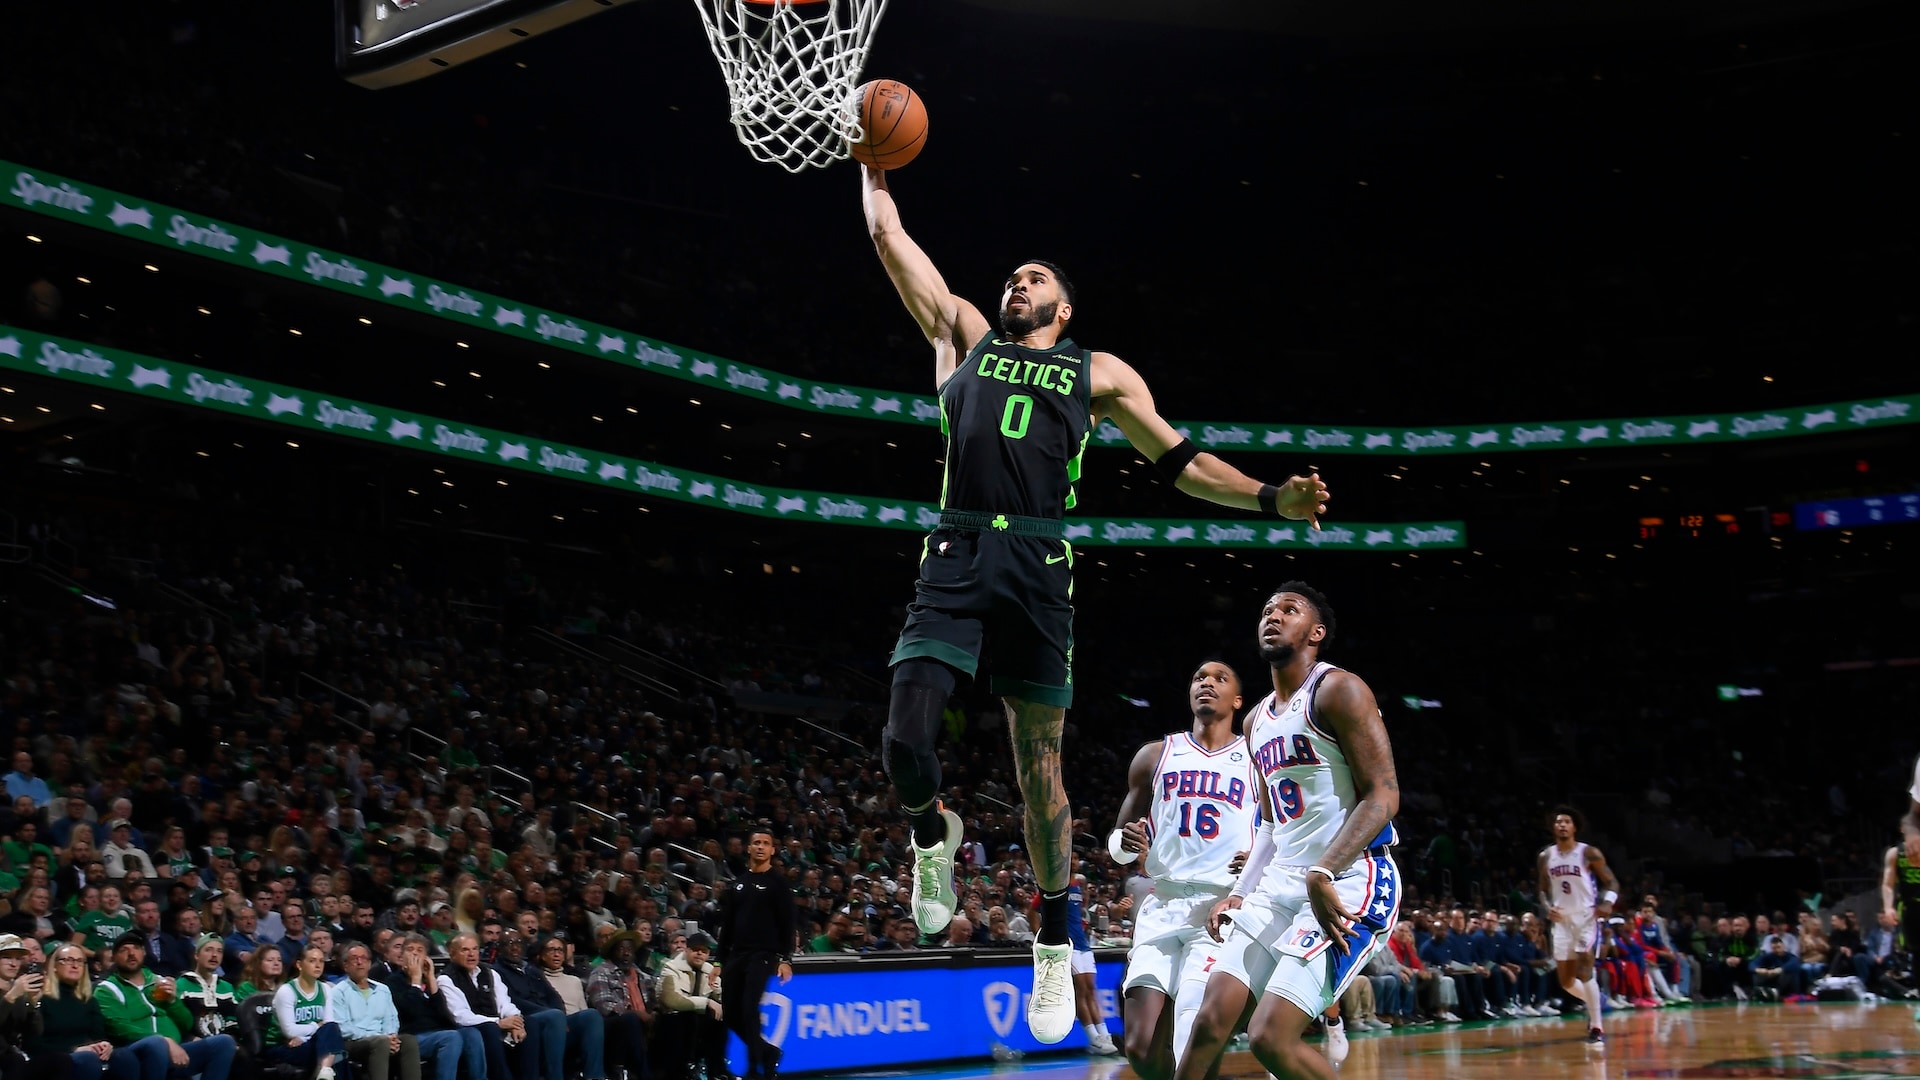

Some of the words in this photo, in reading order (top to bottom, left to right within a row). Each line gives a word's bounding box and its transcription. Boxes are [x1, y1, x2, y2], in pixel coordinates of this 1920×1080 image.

[11, 172, 92, 214] Sprite
[166, 215, 238, 253] Sprite
[303, 252, 367, 287] Sprite
[425, 284, 483, 318] Sprite
[534, 314, 587, 345] Sprite
[634, 340, 682, 370] Sprite
[725, 365, 769, 393] Sprite
[809, 386, 862, 410] Sprite
[1200, 425, 1253, 447] Sprite
[1302, 429, 1353, 449] Sprite
[1401, 431, 1456, 452] Sprite
[976, 352, 1077, 396] CELTICS
[1000, 394, 1034, 440] 0
[36, 342, 114, 378] Sprite
[183, 373, 253, 407] Sprite
[314, 400, 376, 432] Sprite
[431, 424, 488, 454] Sprite
[537, 446, 589, 474] Sprite
[633, 466, 681, 493] Sprite
[722, 484, 766, 510] Sprite
[814, 497, 868, 520] Sprite
[1102, 522, 1155, 544] Sprite
[1204, 524, 1256, 544] Sprite
[1402, 526, 1458, 547] Sprite
[1162, 770, 1246, 810] PHILA
[1270, 778, 1306, 824] 19
[1178, 801, 1221, 840] 16
[1561, 880, 1572, 895] 9
[1203, 956, 1217, 973] 7
[295, 1005, 324, 1022] BOSTO
[797, 998, 930, 1040] FANDUEL
